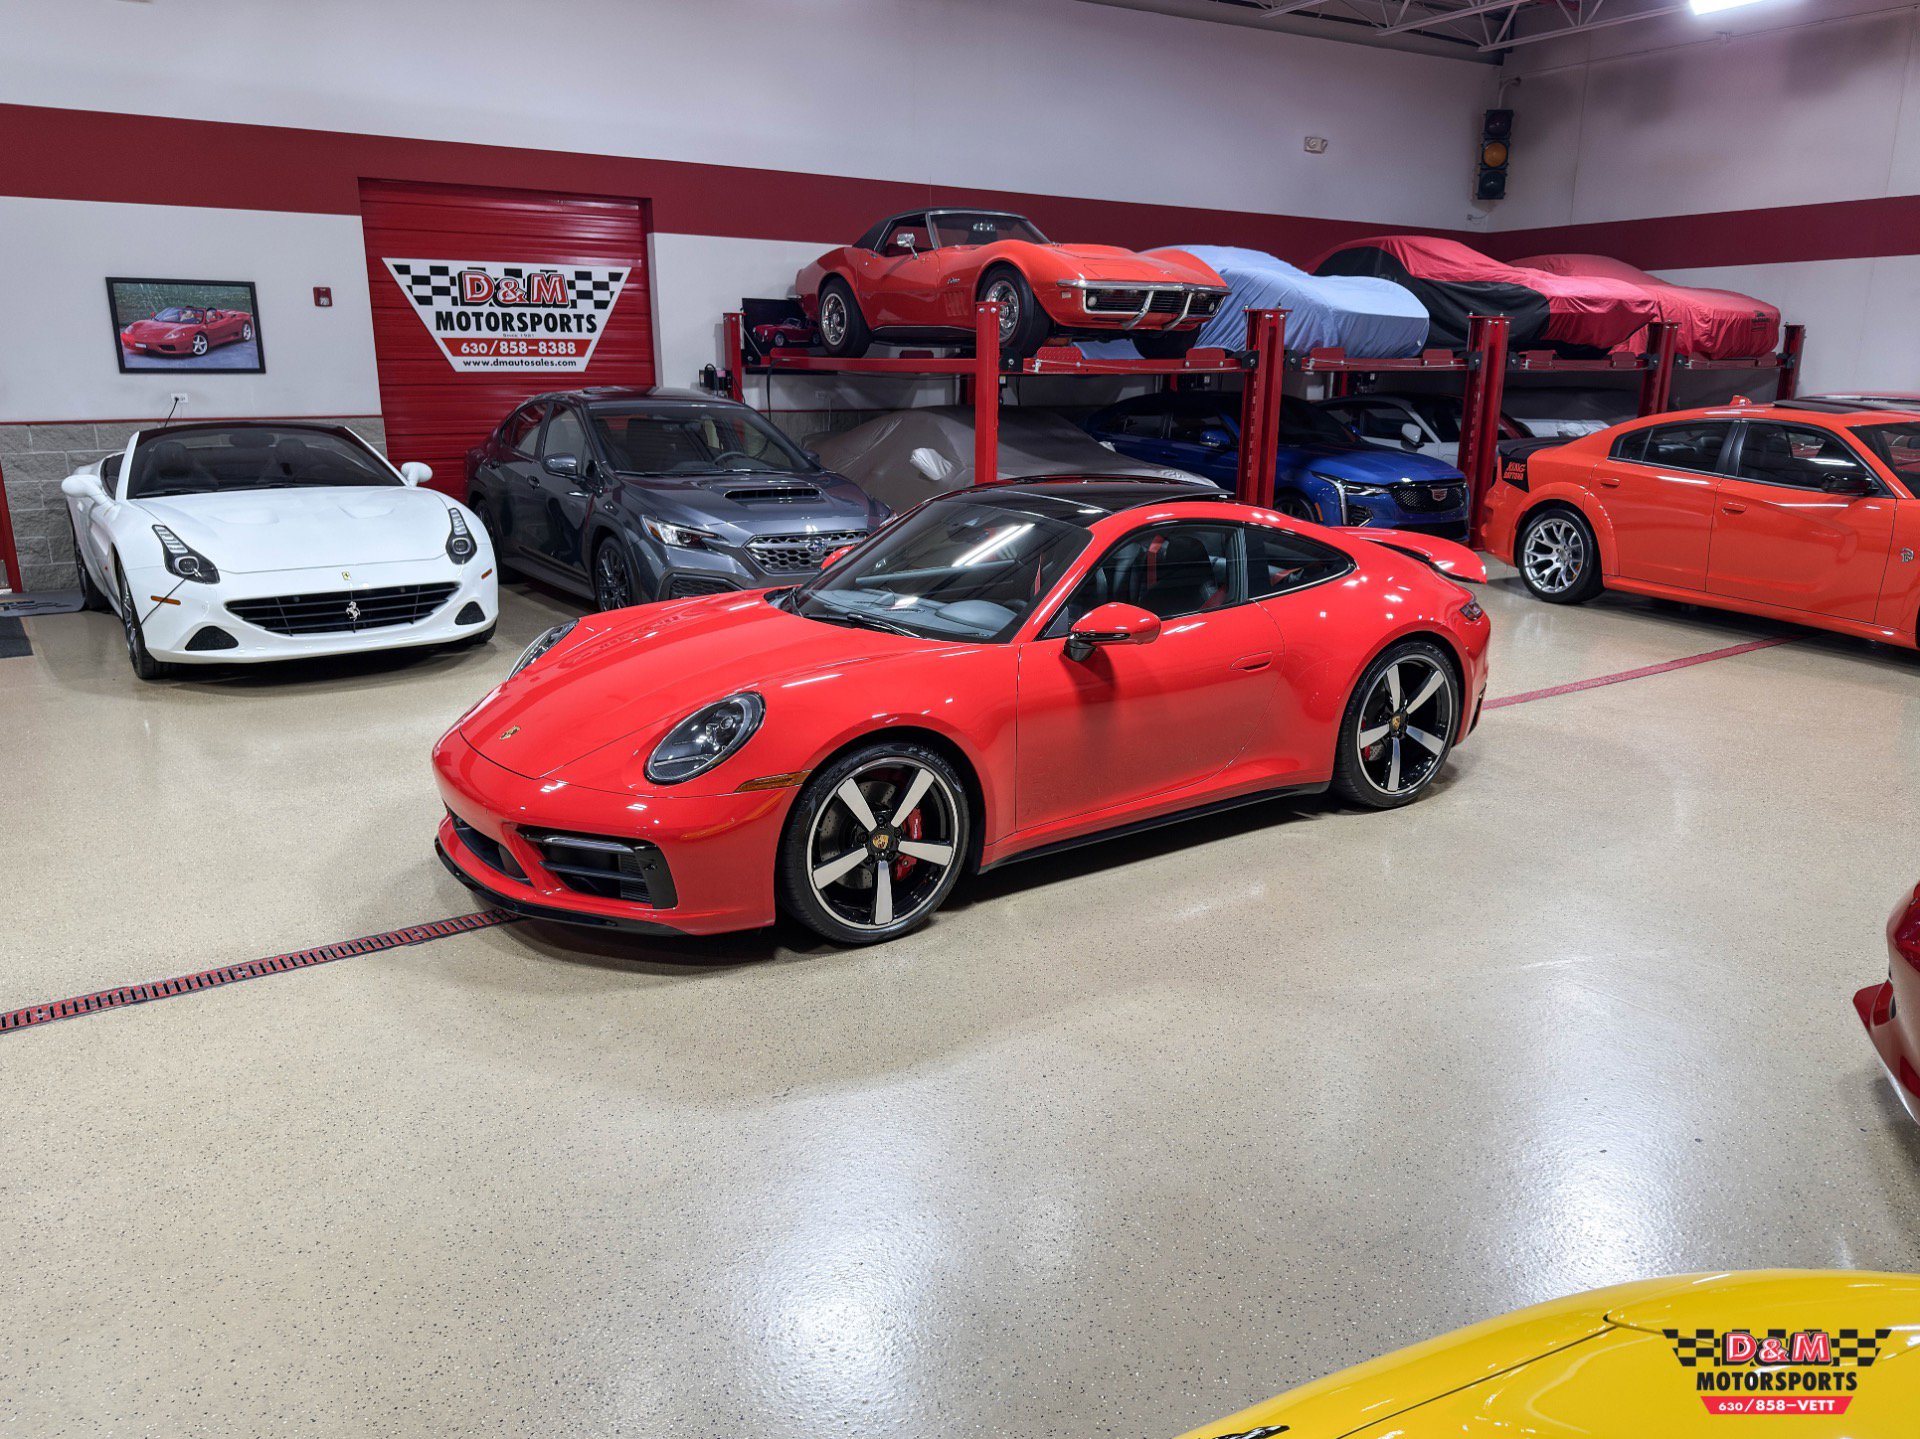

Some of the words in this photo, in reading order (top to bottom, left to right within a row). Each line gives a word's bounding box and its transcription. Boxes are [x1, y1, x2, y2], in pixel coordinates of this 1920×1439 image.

[459, 270, 571, 308] D&M
[435, 311, 597, 333] MOTORSPORTS
[460, 341, 576, 356] 630/858-8388
[463, 358, 577, 368] www.dmautosales.com
